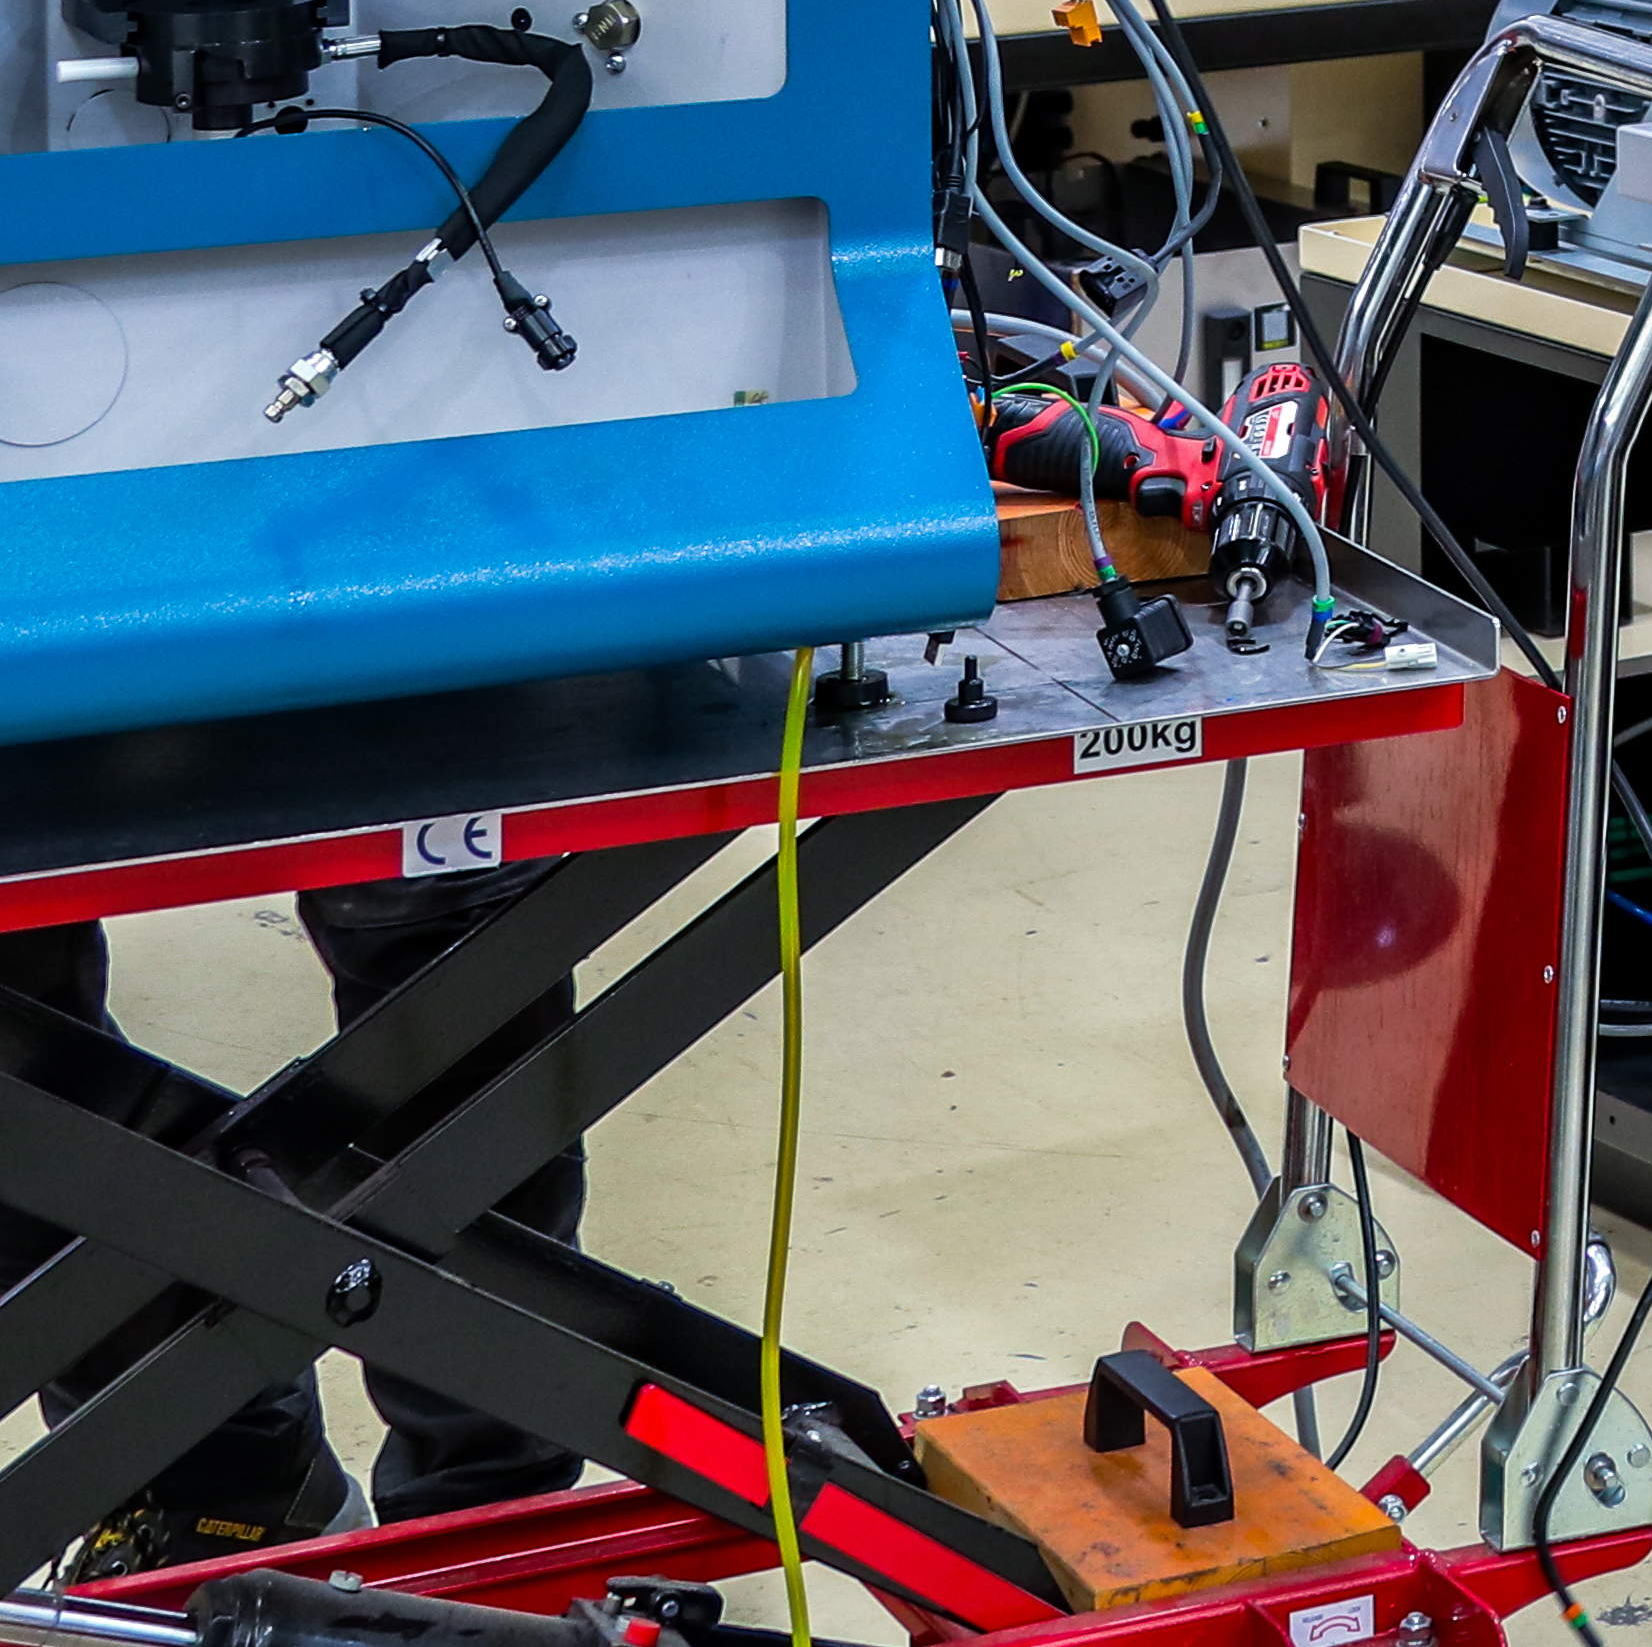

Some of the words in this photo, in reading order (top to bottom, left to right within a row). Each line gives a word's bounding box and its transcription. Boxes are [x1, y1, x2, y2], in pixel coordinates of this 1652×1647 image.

[1079, 719, 1197, 760] 200kg
[416, 815, 493, 866] CE
[196, 1517, 266, 1542] CATERPILLAR
